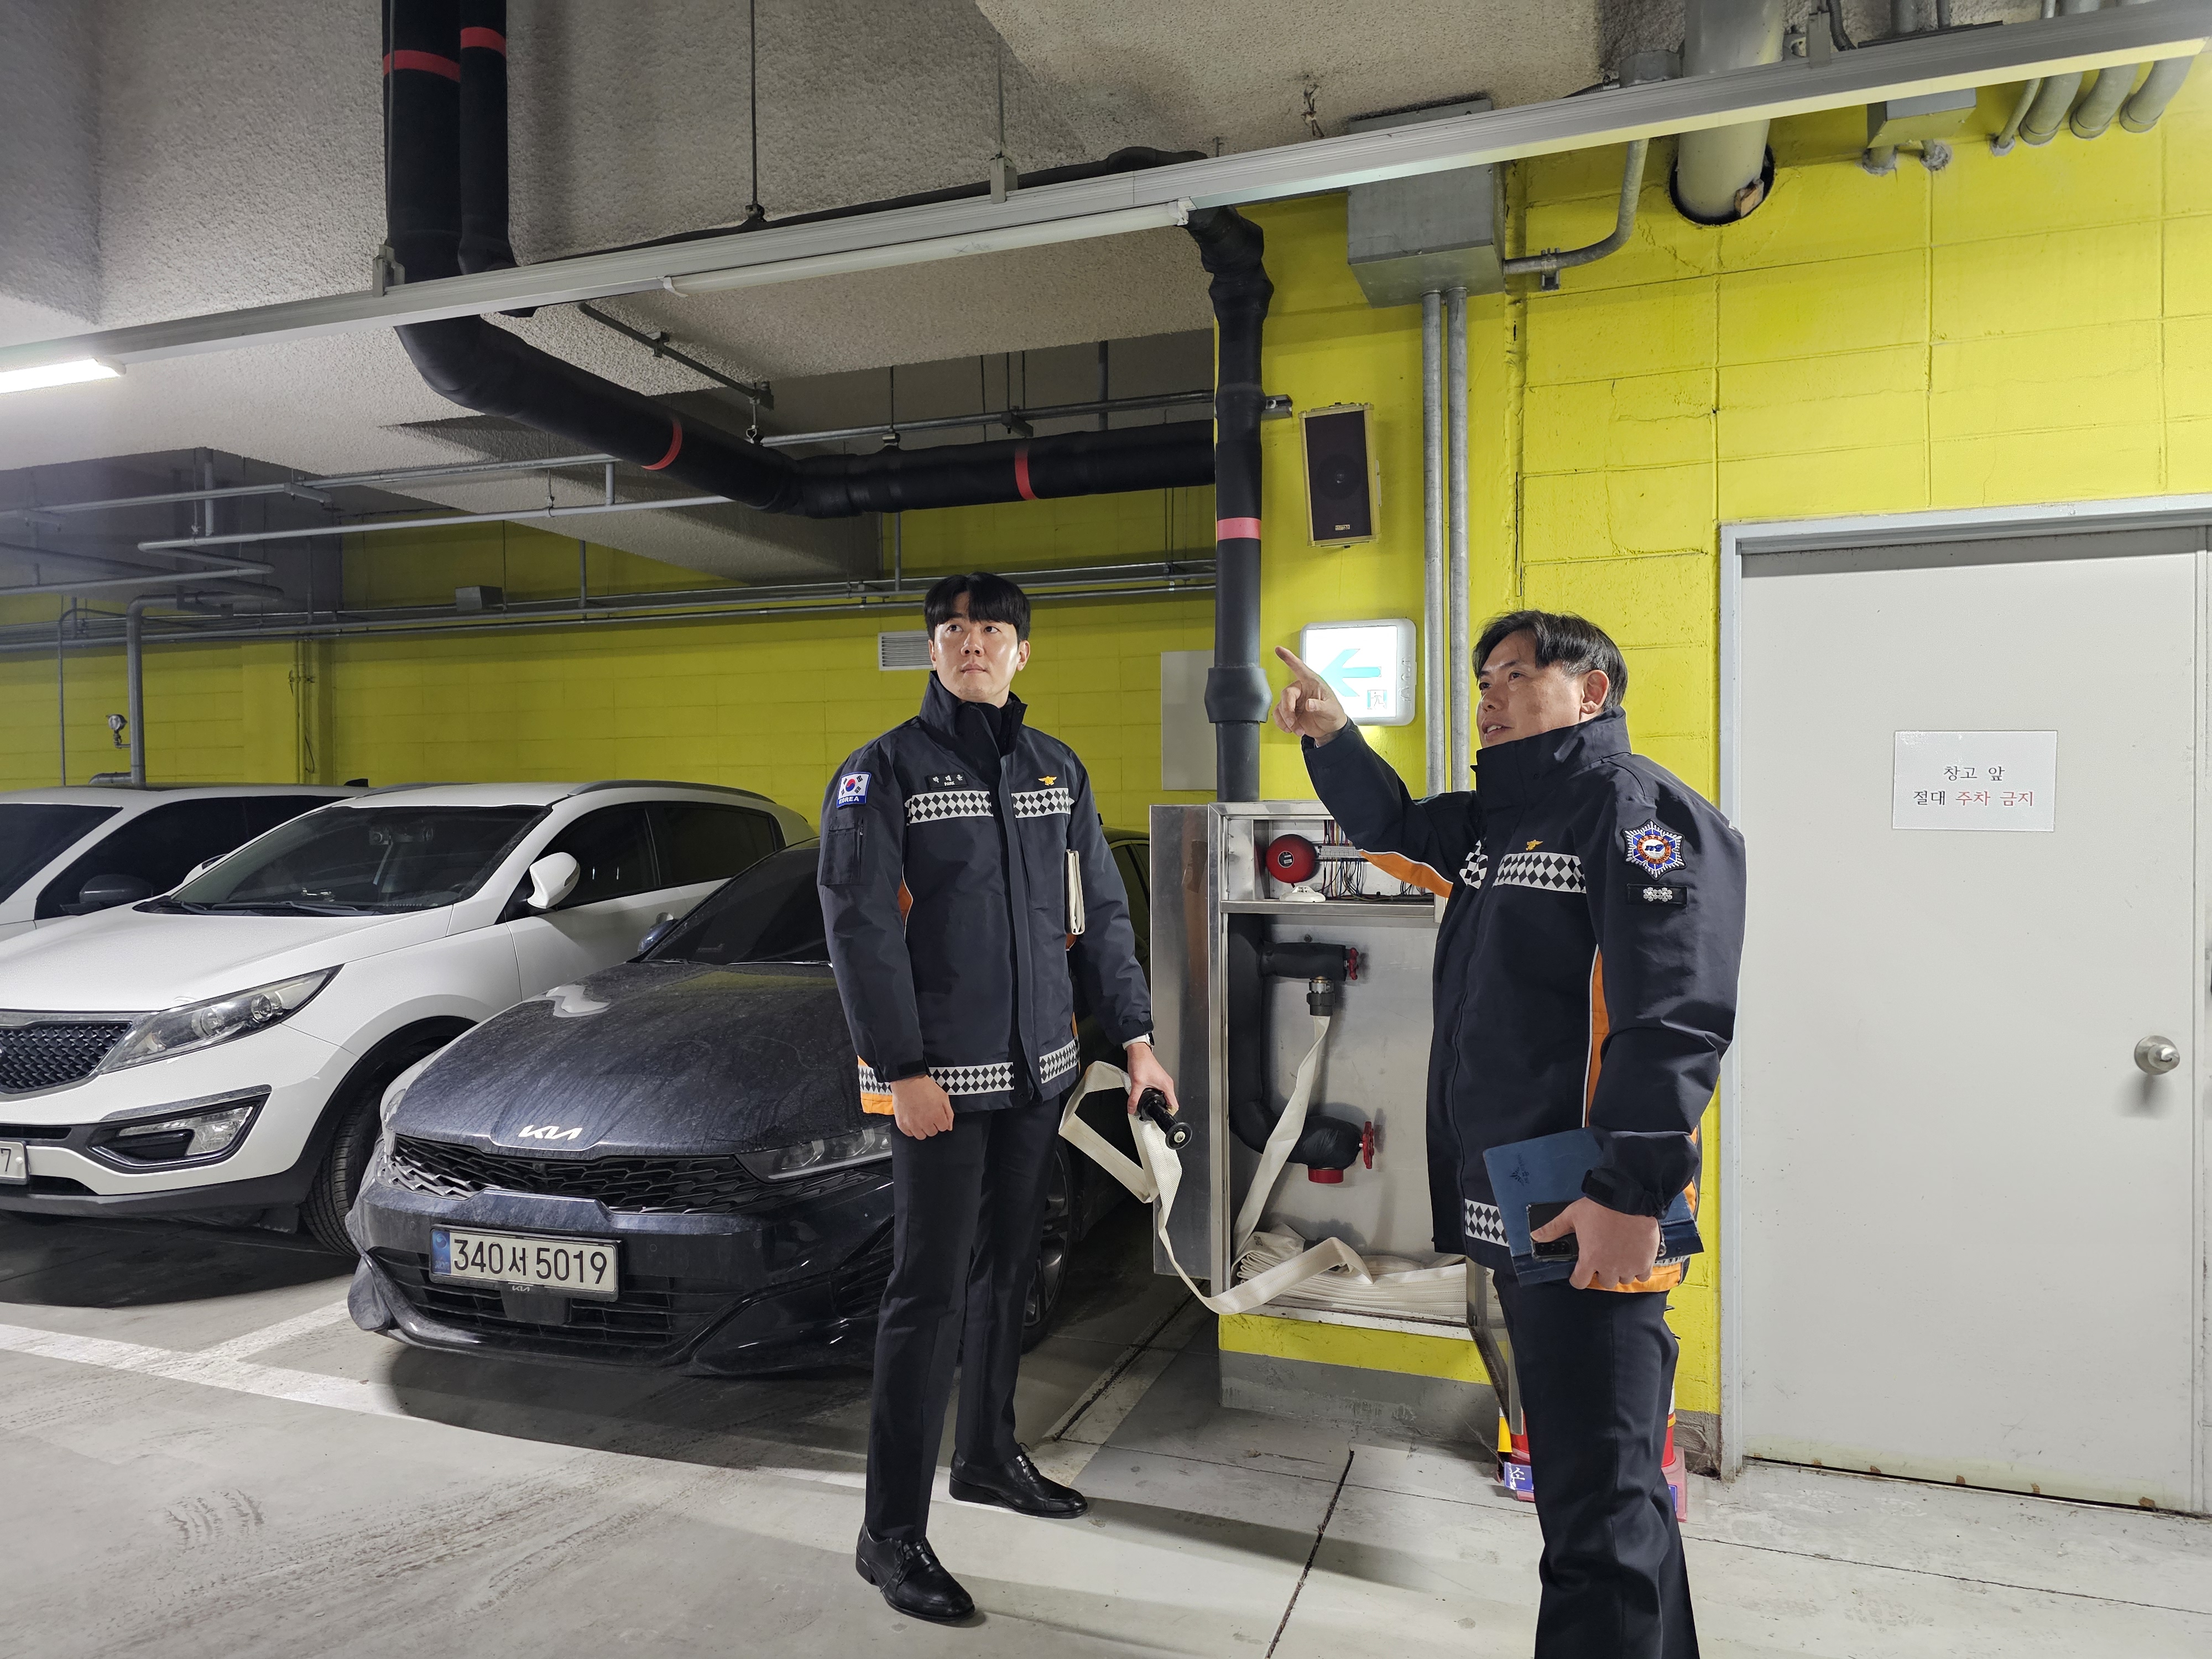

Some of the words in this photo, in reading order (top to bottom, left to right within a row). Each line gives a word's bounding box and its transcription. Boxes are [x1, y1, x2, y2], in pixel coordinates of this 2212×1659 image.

[1943, 765, 1978, 781] 창고
[1988, 765, 2005, 781] 앞
[838, 796, 859, 805] KOREA
[1913, 790, 1946, 806] 절대
[1955, 790, 1991, 806] 주차
[1999, 791, 2033, 807] 금지
[453, 1239, 526, 1276] 340서
[535, 1247, 608, 1285] 5019
